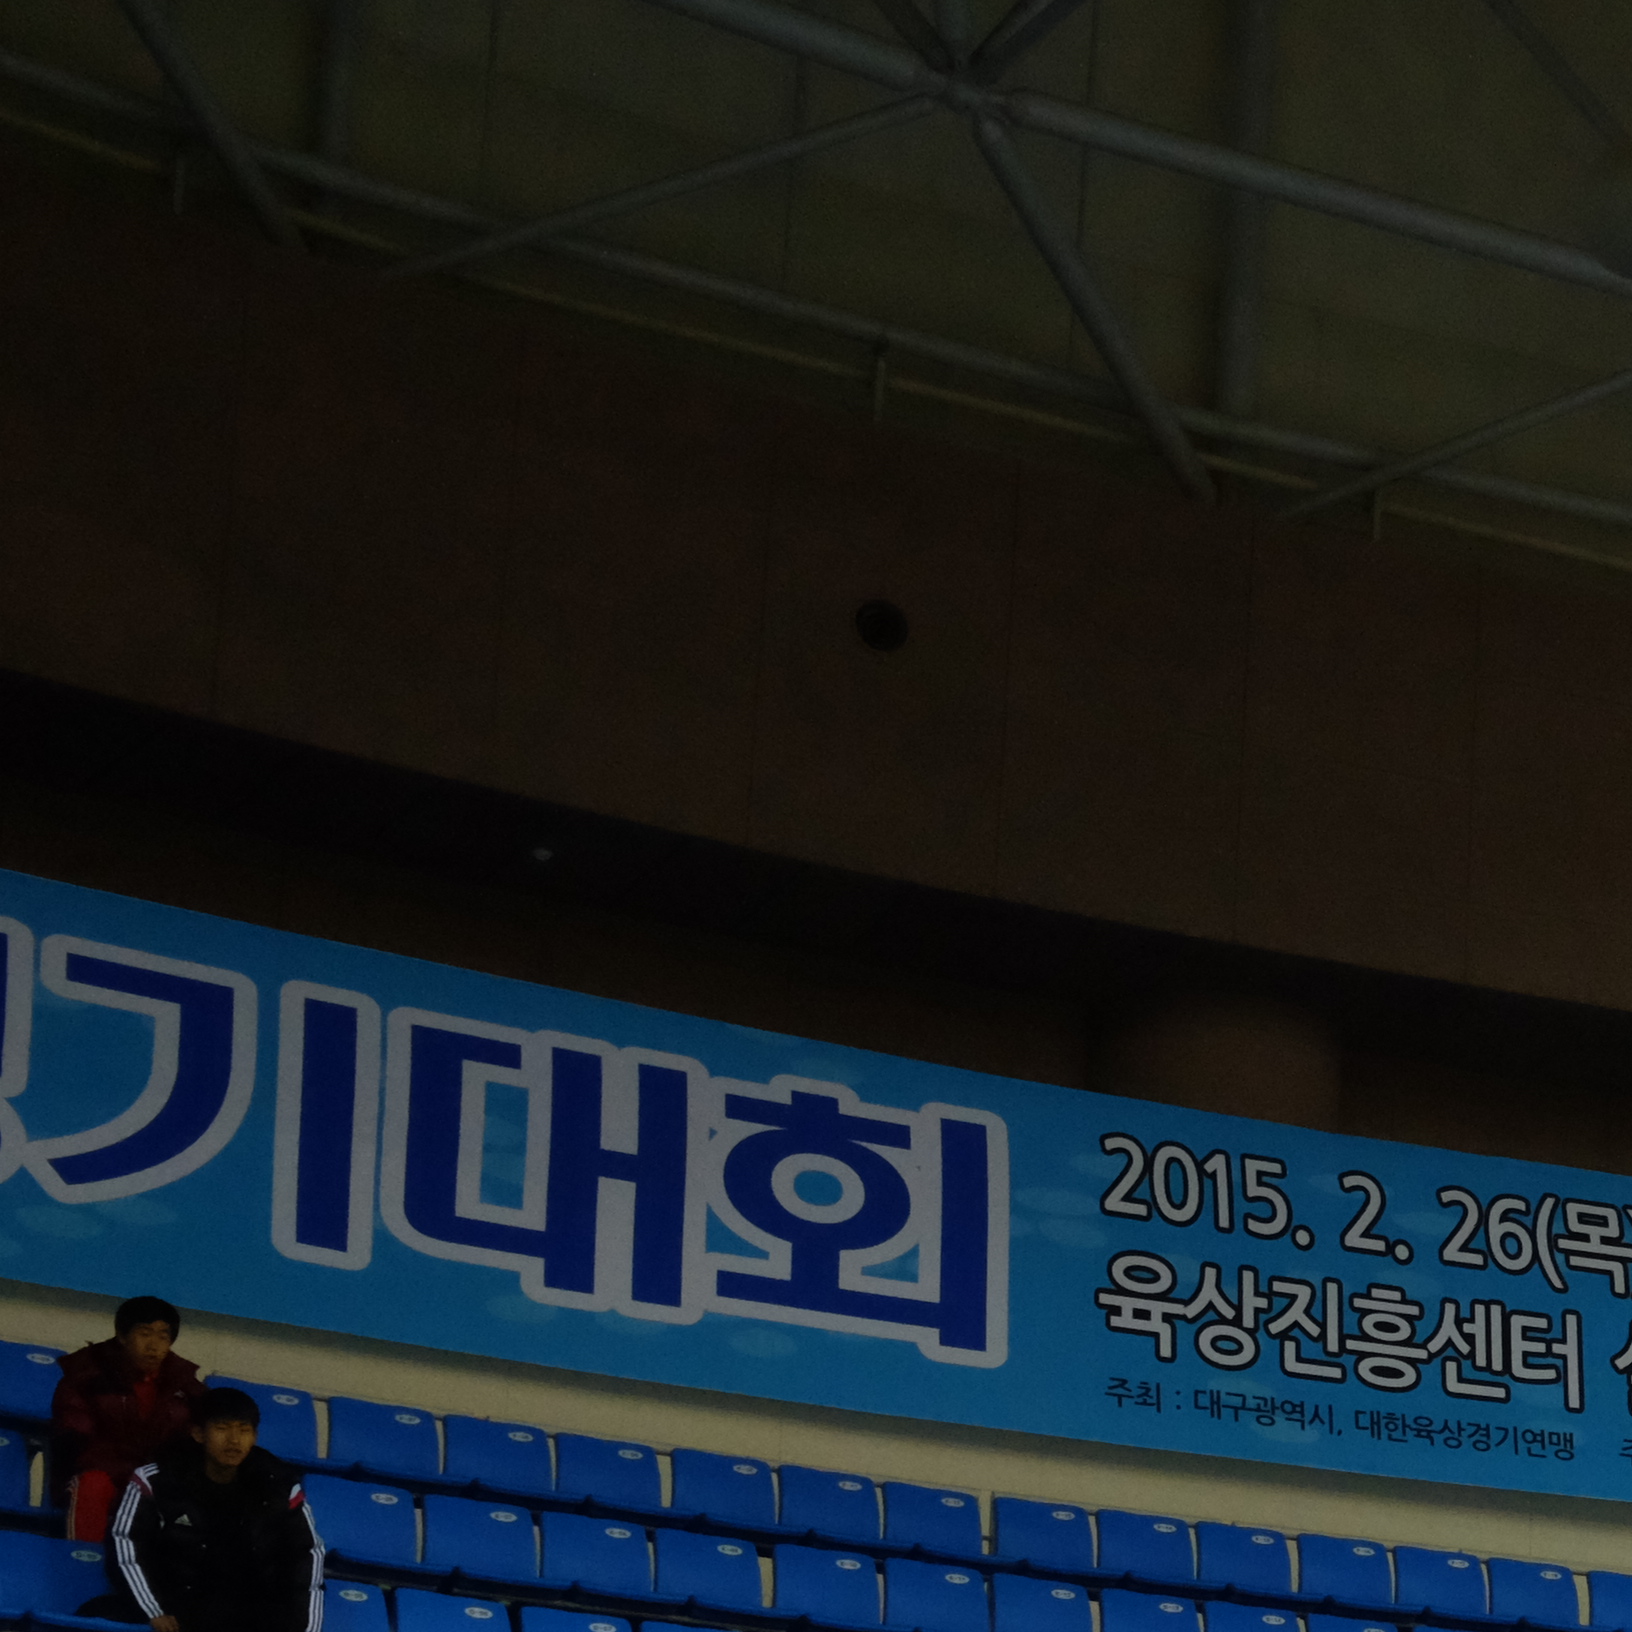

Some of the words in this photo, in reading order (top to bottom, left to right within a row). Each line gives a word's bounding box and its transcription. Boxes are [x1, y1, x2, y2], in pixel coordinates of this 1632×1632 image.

[0, 918, 1006, 1366] 기대회
[1097, 1134, 1313, 1248] 2015.
[1339, 1172, 1414, 1262] 2.
[1095, 1251, 1586, 1410] 육상진흥센터
[1105, 1378, 1162, 1412] 주최
[1194, 1388, 1342, 1436] 대구광역시,
[1355, 1409, 1575, 1461] 대한육상경기연맹
